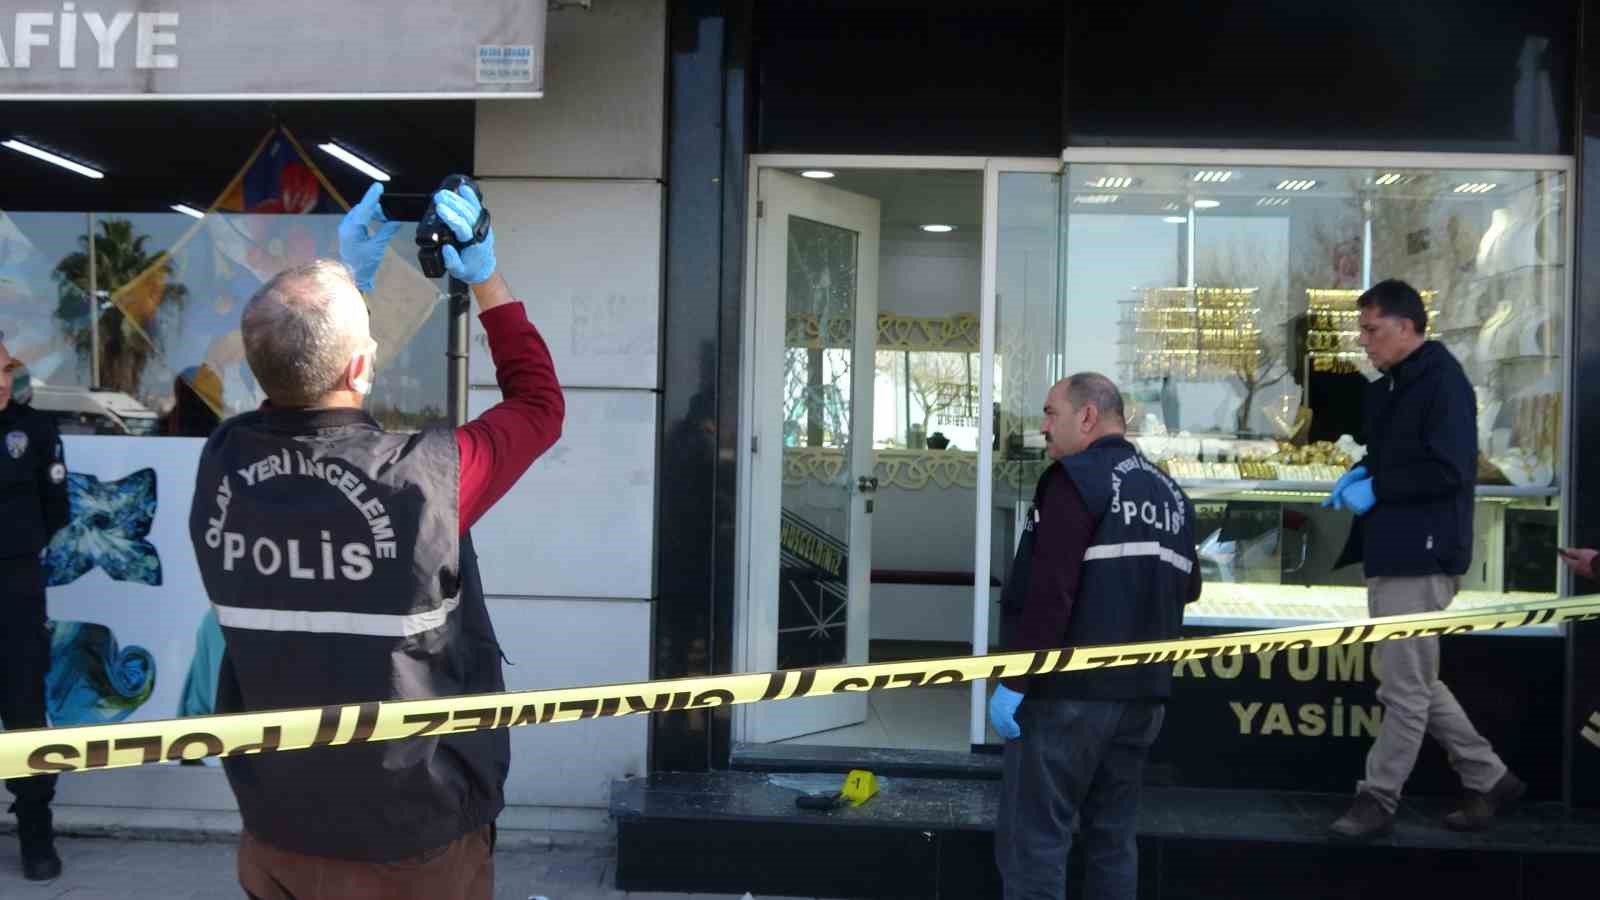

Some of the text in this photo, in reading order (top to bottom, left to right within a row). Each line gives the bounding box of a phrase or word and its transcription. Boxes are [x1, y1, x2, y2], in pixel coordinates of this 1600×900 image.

[205, 475, 232, 548] OLAY
[223, 530, 373, 580] POLİS
[1172, 642, 1384, 682] UYUM
[1229, 697, 1383, 737] YASİN
